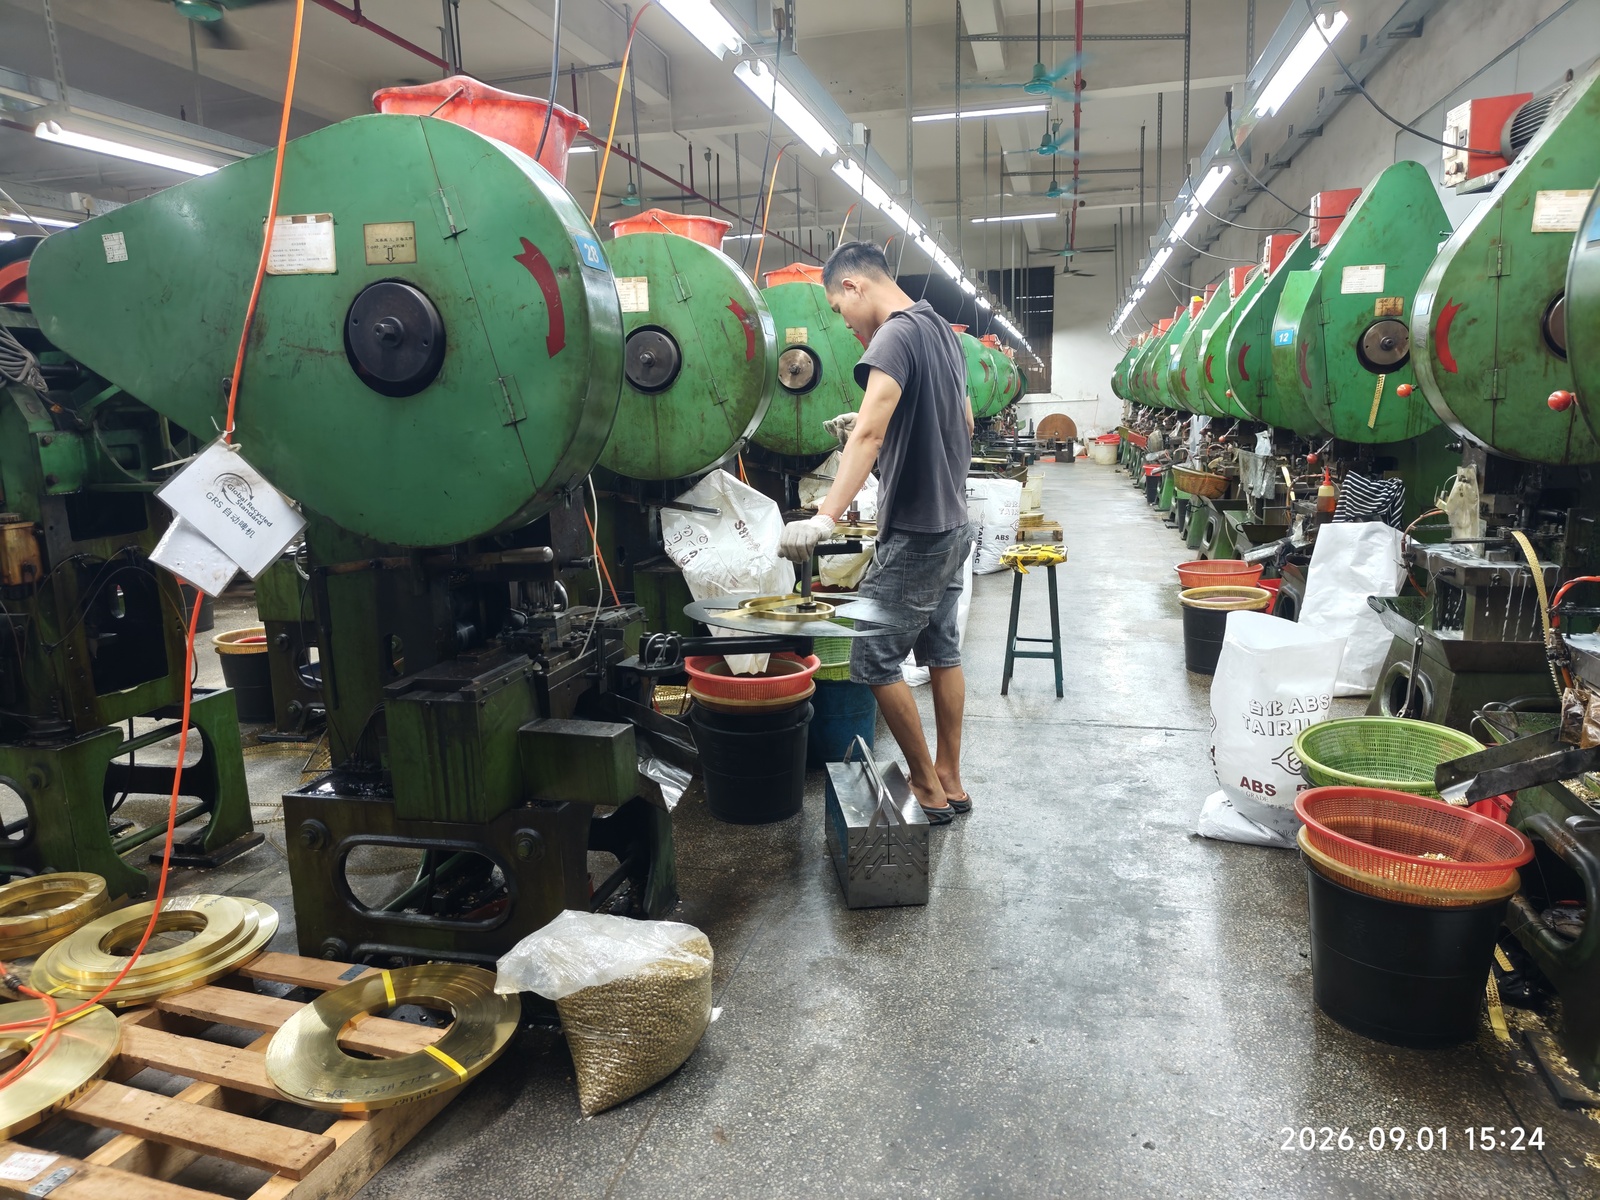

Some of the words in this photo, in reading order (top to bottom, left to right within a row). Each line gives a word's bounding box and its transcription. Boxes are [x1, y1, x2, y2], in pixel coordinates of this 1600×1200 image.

[583, 243, 600, 264] 28
[1278, 332, 1290, 343] 12
[205, 491, 224, 509] GRS
[222, 507, 256, 539] 自动啤机
[227, 483, 248, 503] Global
[246, 501, 273, 528] Recycled
[235, 499, 263, 526] Standard
[1249, 699, 1284, 716] 台化
[1288, 693, 1330, 714] ABS
[1242, 713, 1326, 736] TAIRI
[1239, 775, 1277, 797] ABS
